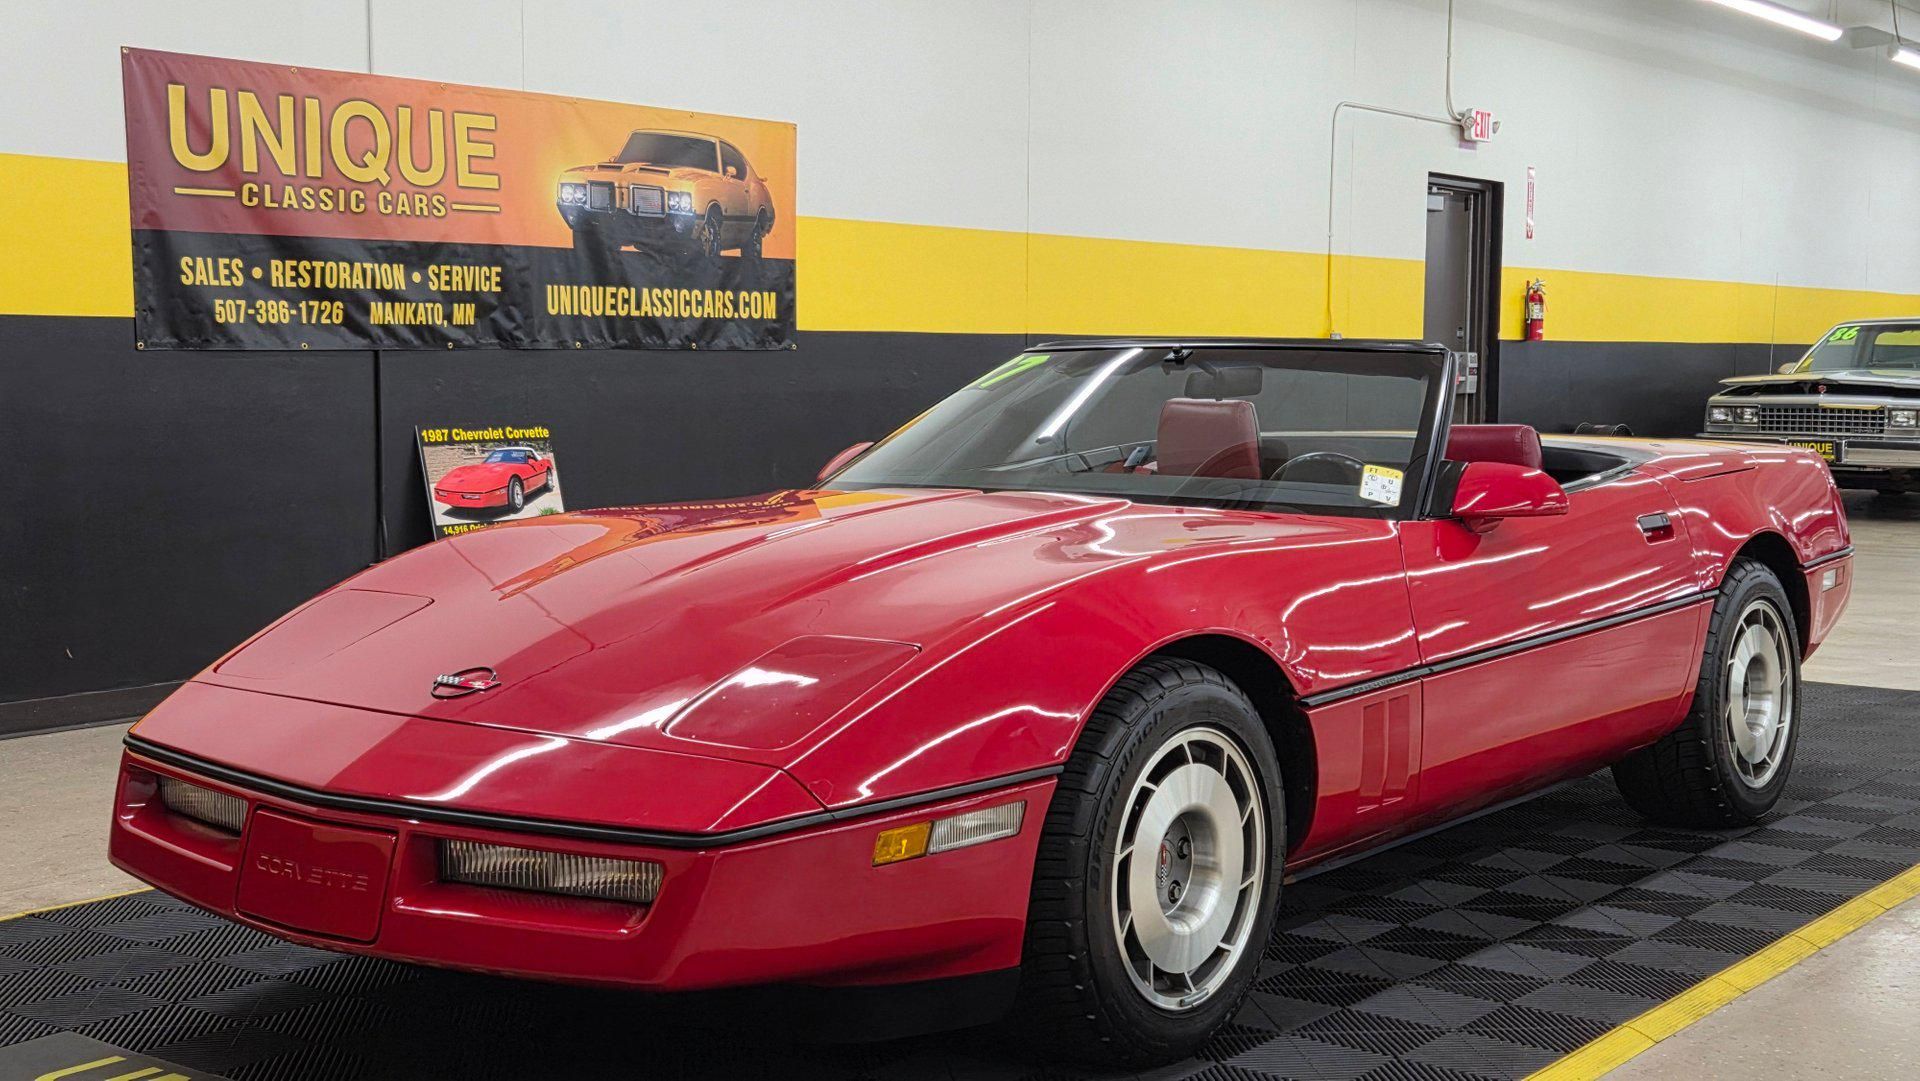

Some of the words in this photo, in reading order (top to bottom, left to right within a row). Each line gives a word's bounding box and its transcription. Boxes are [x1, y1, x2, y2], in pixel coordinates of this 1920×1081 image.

[167, 83, 500, 189] UNIQUE
[1474, 110, 1491, 139] EXIT
[241, 182, 365, 214] CLASSIC
[378, 190, 447, 217] CARS
[180, 256, 244, 287] SALES
[270, 259, 406, 290] RESTORATION
[428, 265, 502, 292] SERVICE
[214, 299, 344, 325] 507-386-1726
[369, 302, 448, 327] MANKATO,
[452, 303, 475, 325] MN
[546, 285, 777, 319] UNIQUECLASSICCARS.COM
[1828, 326, 1861, 341] 86
[421, 429, 448, 442] 1987
[452, 428, 503, 441] Chevrolet
[505, 426, 549, 439] Corvette
[256, 854, 369, 891] CORVETTE
